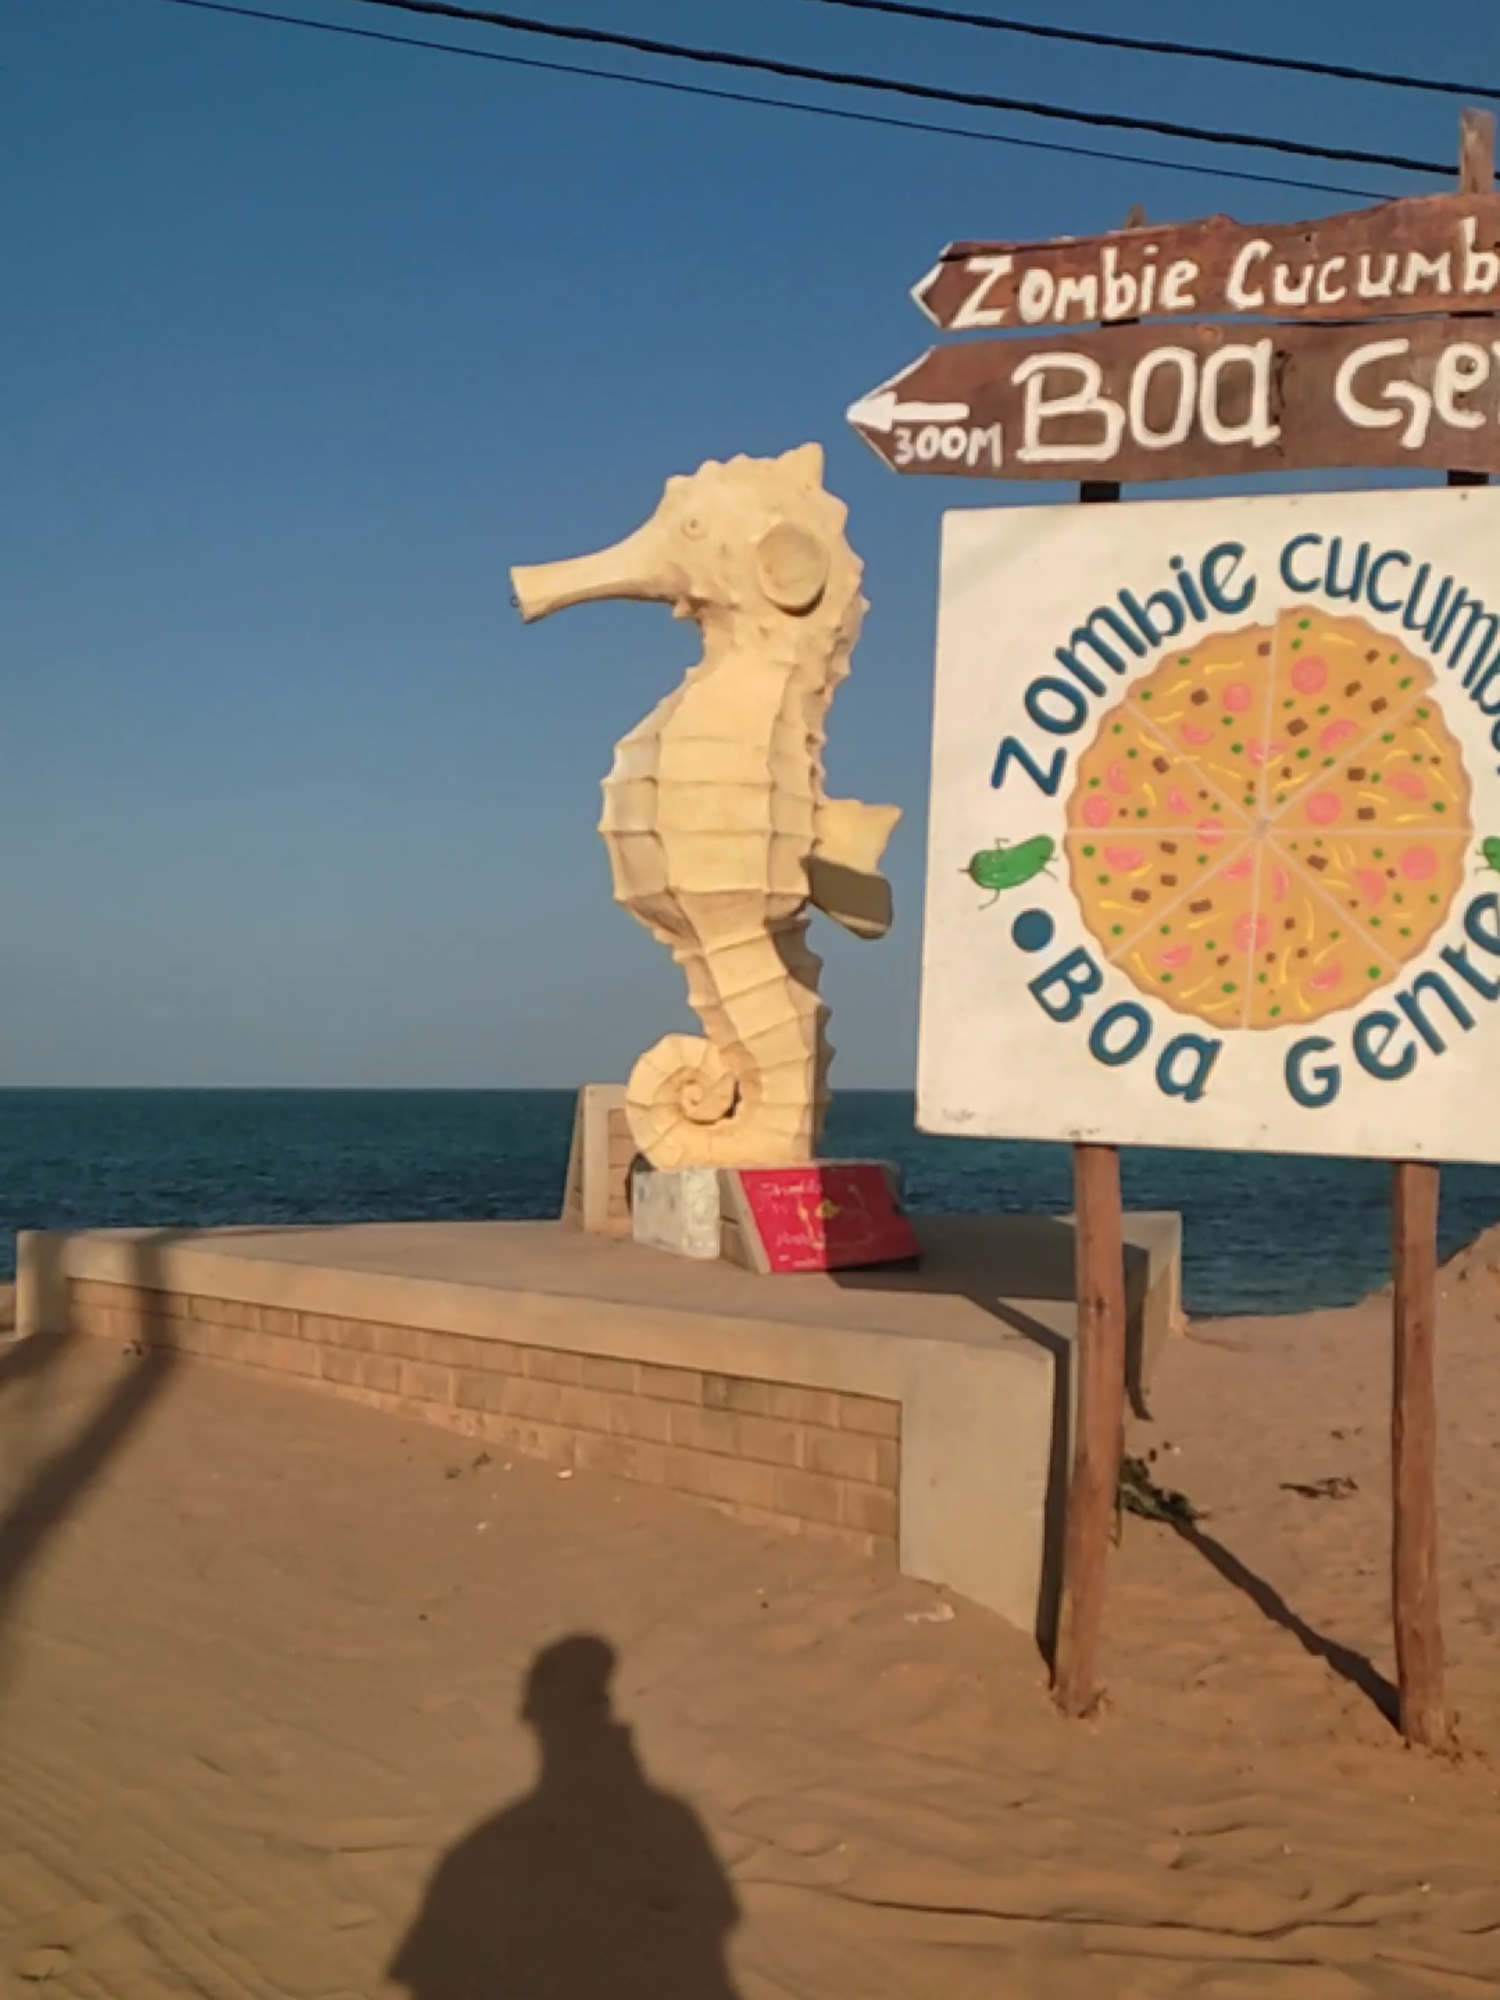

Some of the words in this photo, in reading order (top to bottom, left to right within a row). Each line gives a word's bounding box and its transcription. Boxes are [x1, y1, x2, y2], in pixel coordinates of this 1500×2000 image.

[951, 245, 1199, 330] Zombie
[1011, 338, 1282, 463] Boa
[1334, 337, 1500, 449] Ge
[990, 541, 1257, 797] Zombie
[1027, 945, 1223, 1104] Boa
